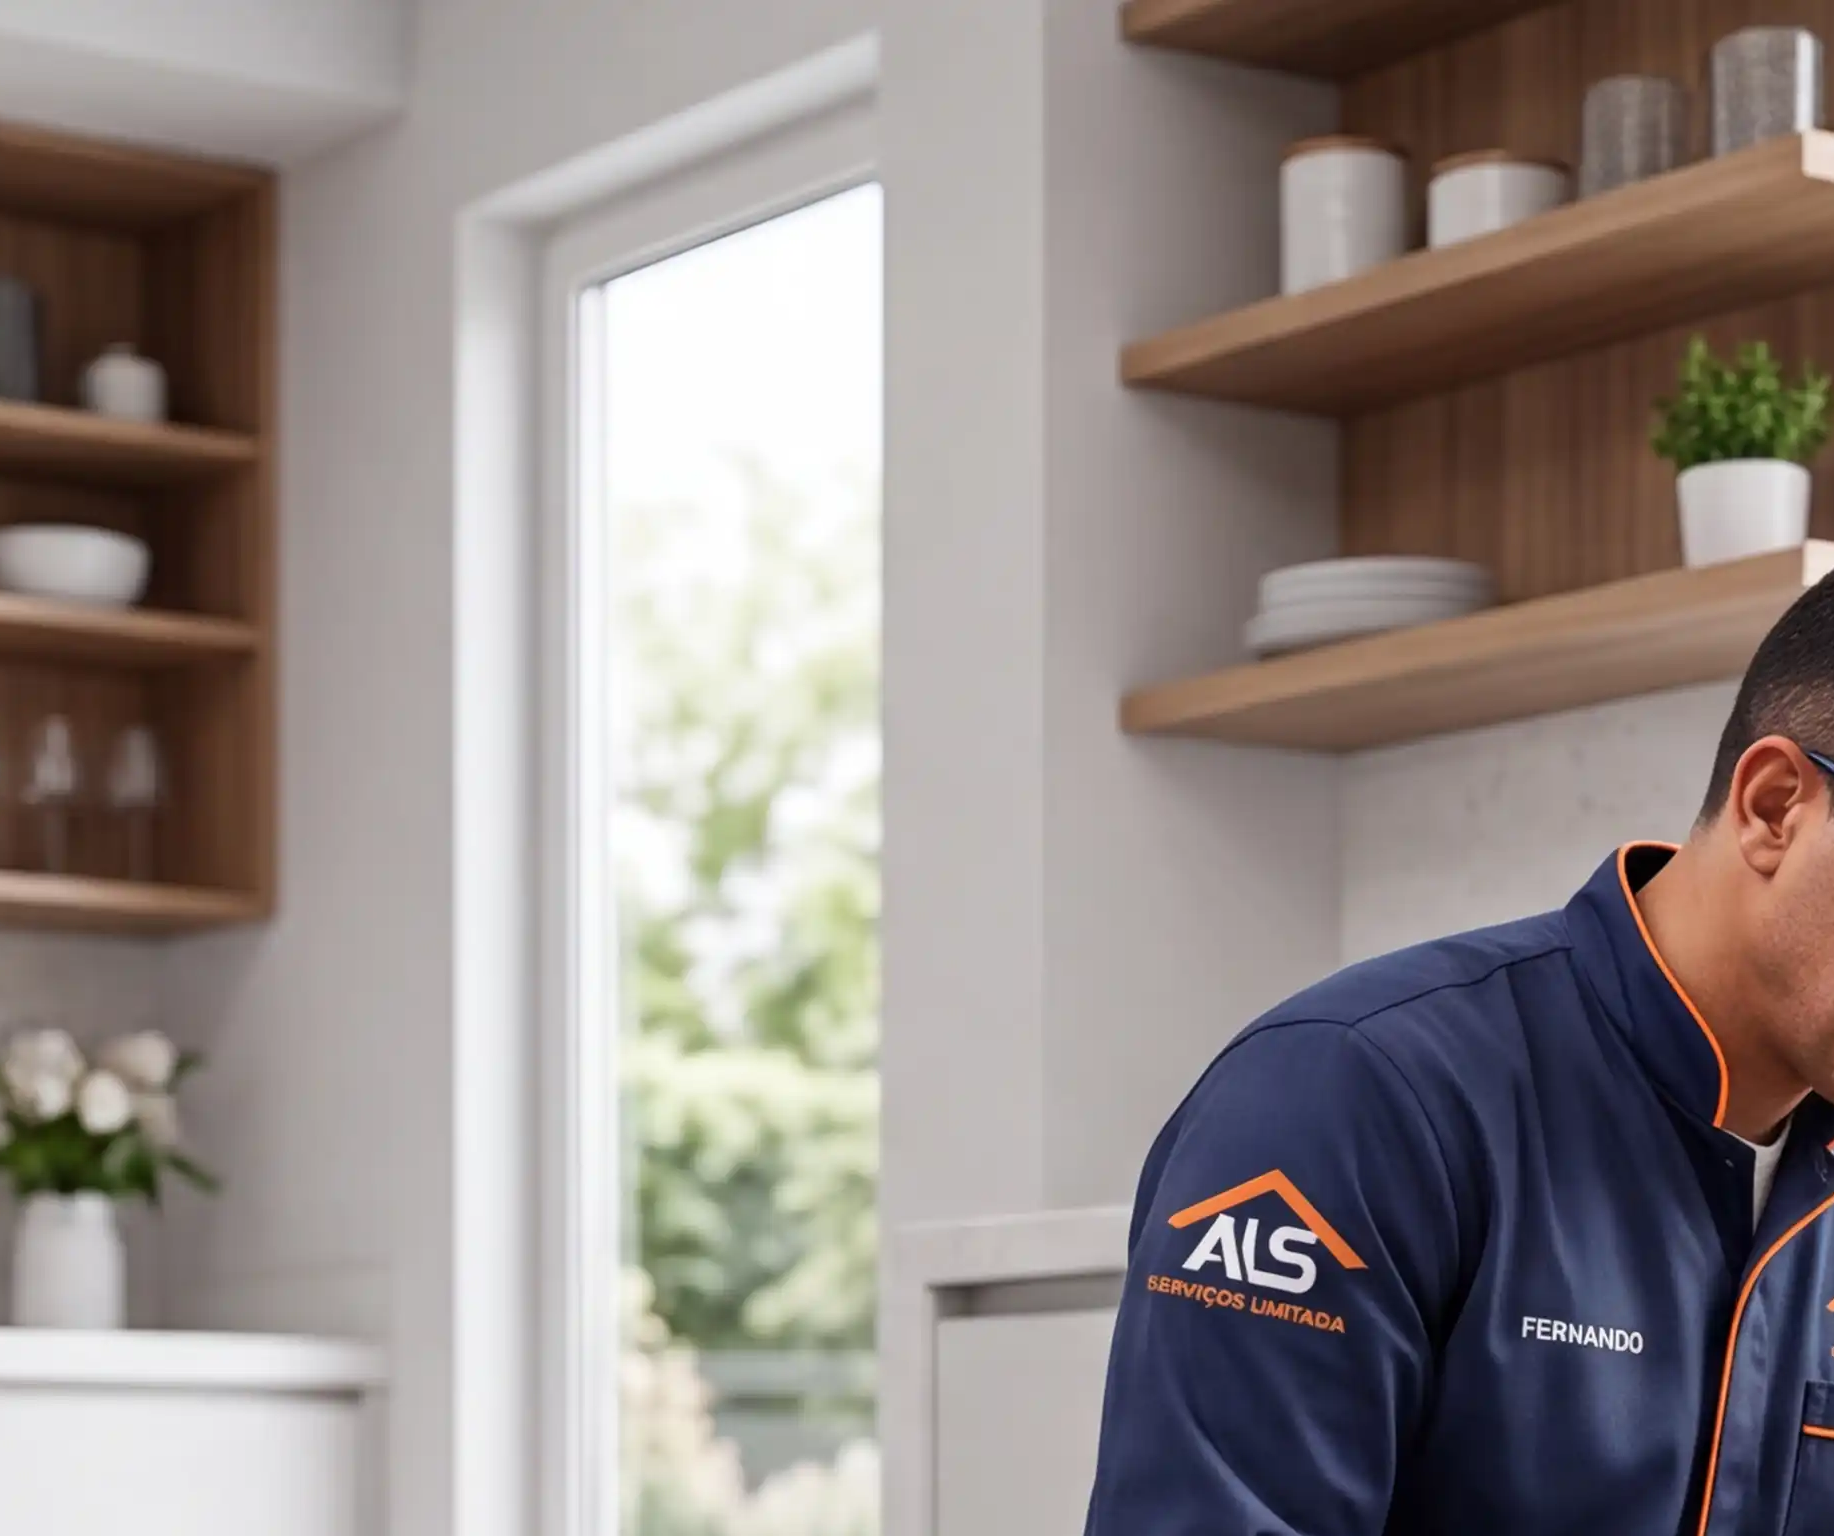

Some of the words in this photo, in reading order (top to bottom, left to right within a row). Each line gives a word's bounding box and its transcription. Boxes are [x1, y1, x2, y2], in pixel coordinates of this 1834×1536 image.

[1181, 1212, 1319, 1294] ALS
[1146, 1274, 1245, 1308] SERVIÇOS
[1521, 1315, 1644, 1355] FERNANDO
